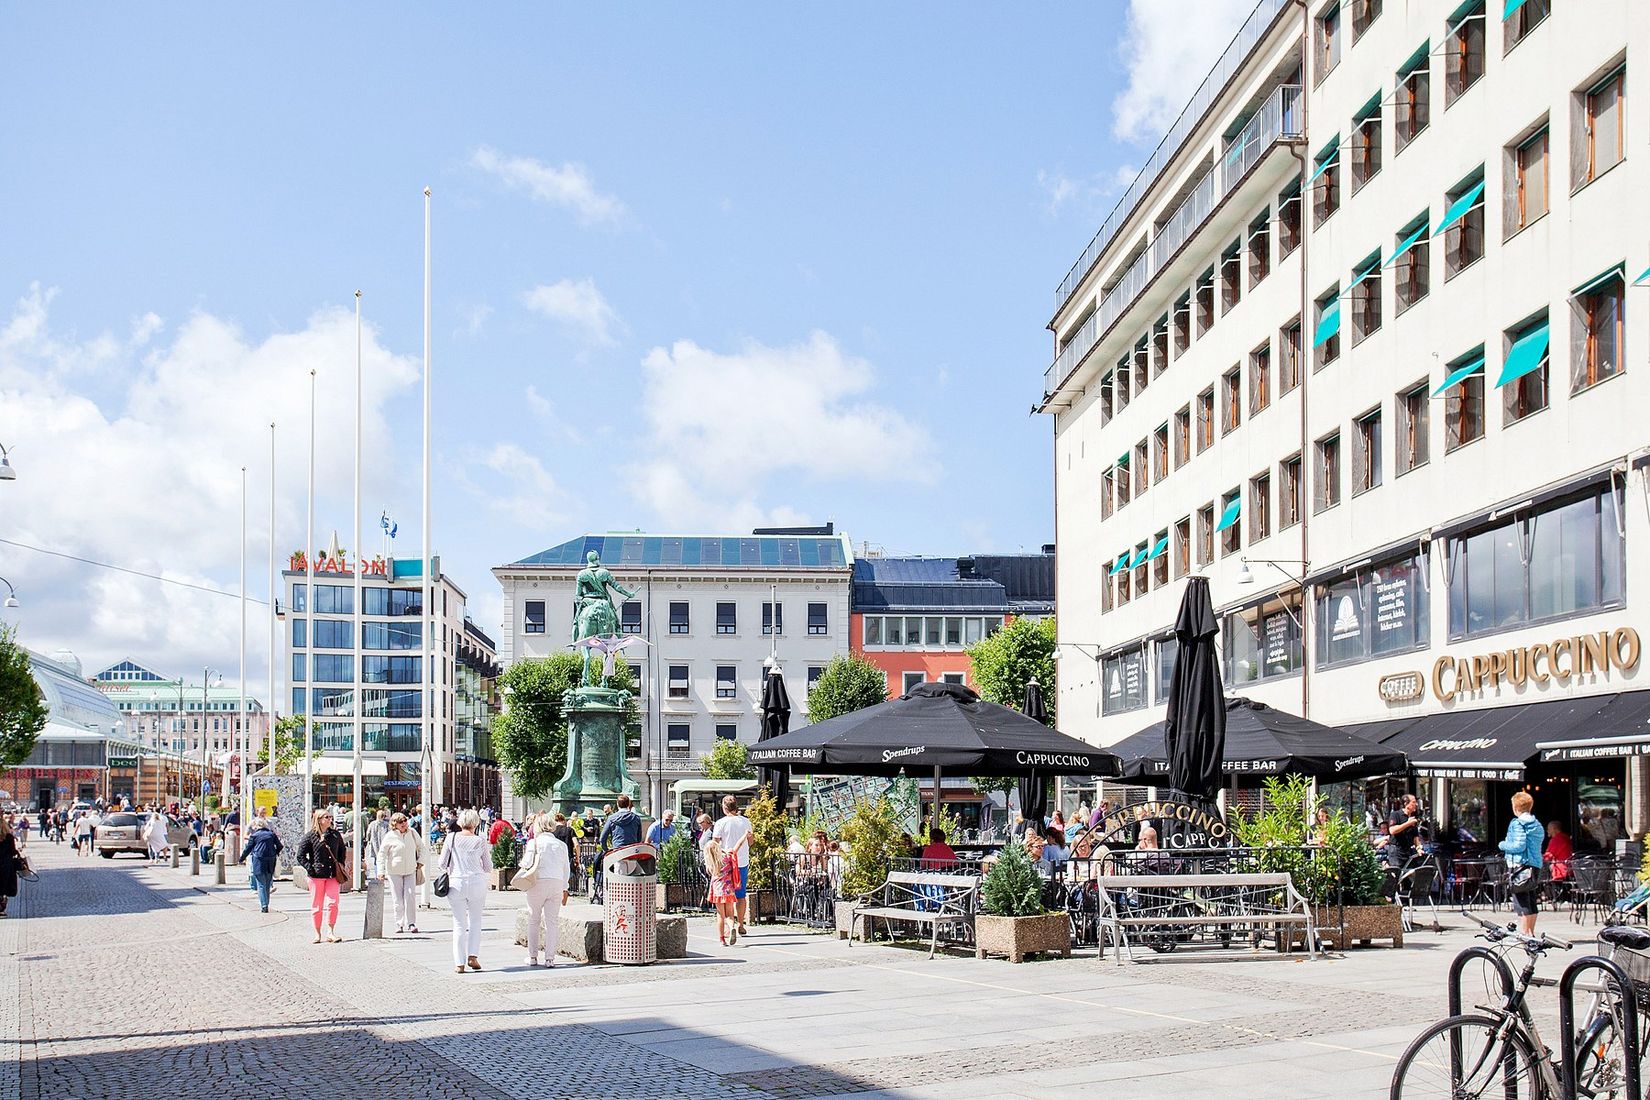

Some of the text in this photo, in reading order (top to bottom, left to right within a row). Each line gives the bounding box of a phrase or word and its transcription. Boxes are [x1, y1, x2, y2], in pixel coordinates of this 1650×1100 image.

[1432, 627, 1641, 701] CAPPUCCINO
[1380, 676, 1417, 697] COFFEE
[751, 748, 817, 760] ITALIAN COFFEE BAR
[882, 745, 925, 763] Spendrups
[1016, 751, 1090, 767] CAPPUCCINO
[1594, 746, 1618, 757] COFFEE
[1618, 745, 1633, 755] BAR
[1221, 760, 1276, 770] FFEE BAR
[1335, 754, 1365, 772] Spendrups
[1481, 770, 1497, 778] FOOD
